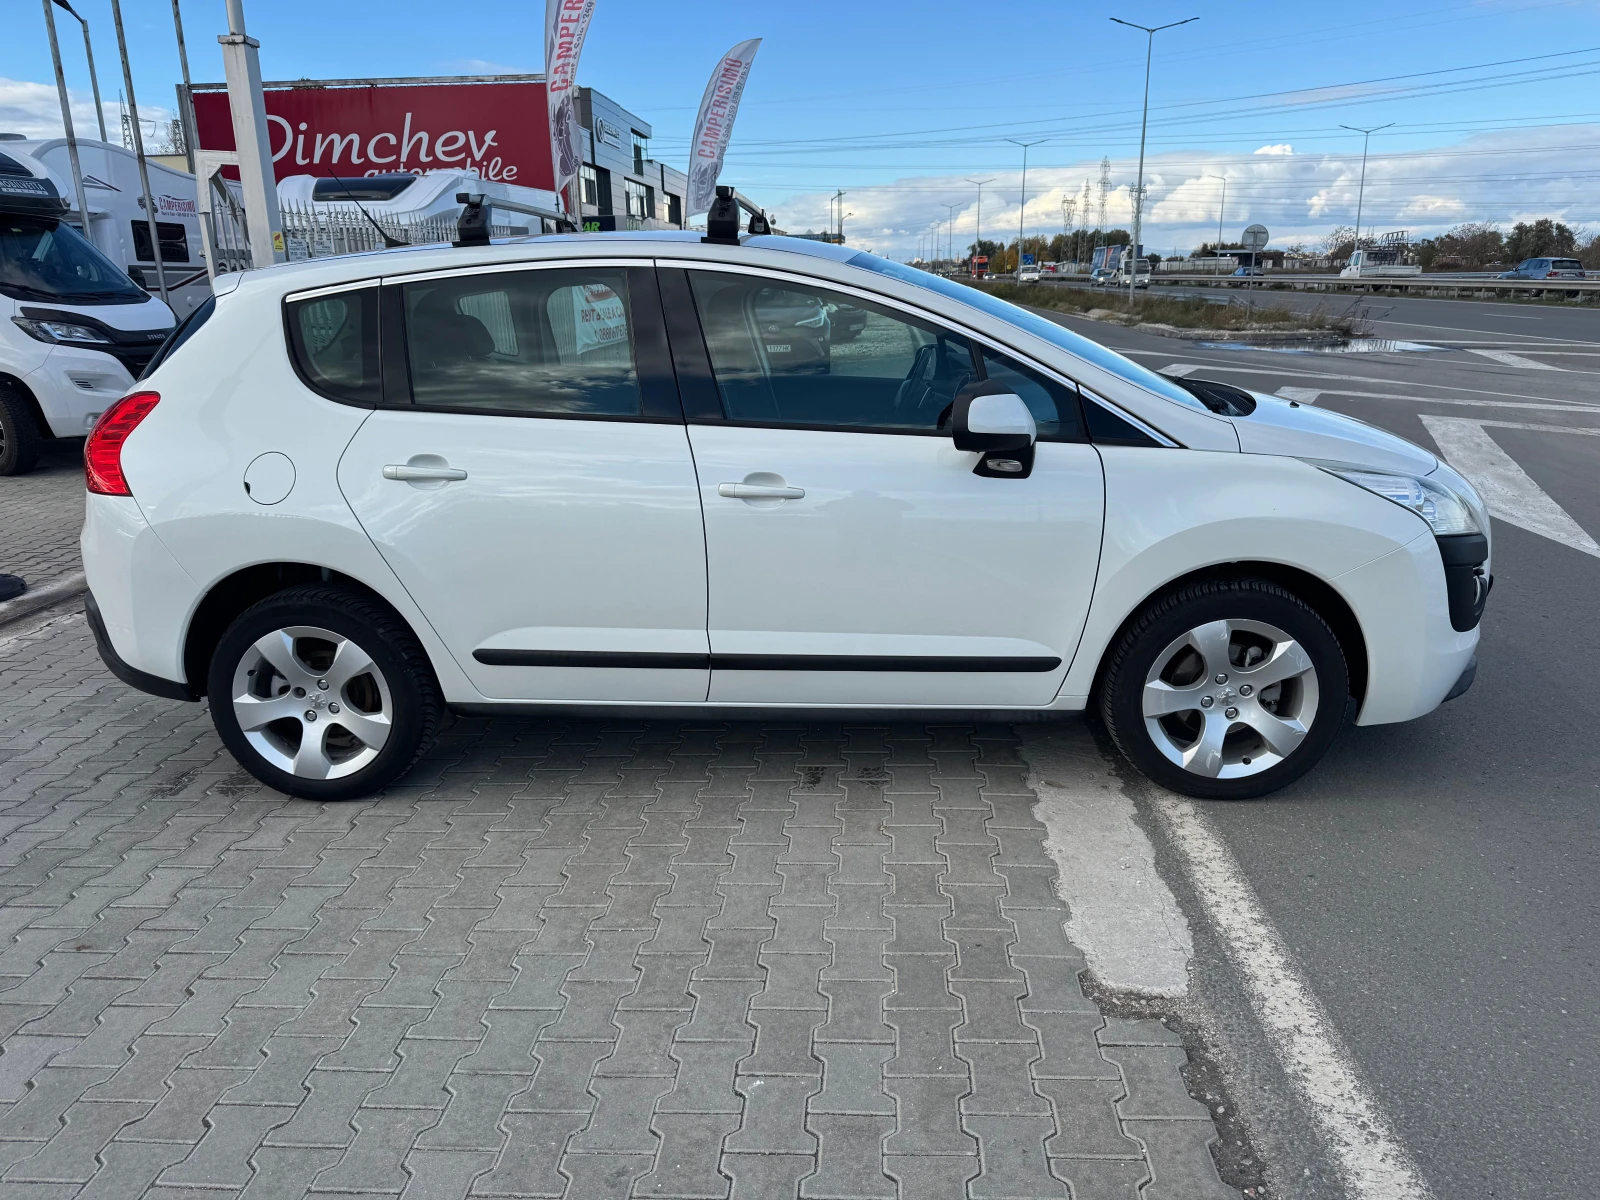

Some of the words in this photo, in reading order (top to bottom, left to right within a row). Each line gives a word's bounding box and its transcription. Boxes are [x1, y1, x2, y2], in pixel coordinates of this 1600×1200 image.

[698, 57, 743, 159] CAMPERISIMO
[732, 91, 740, 104] 888
[267, 112, 498, 165] Dimchev
[159, 197, 196, 212] CAMPERISIMO
